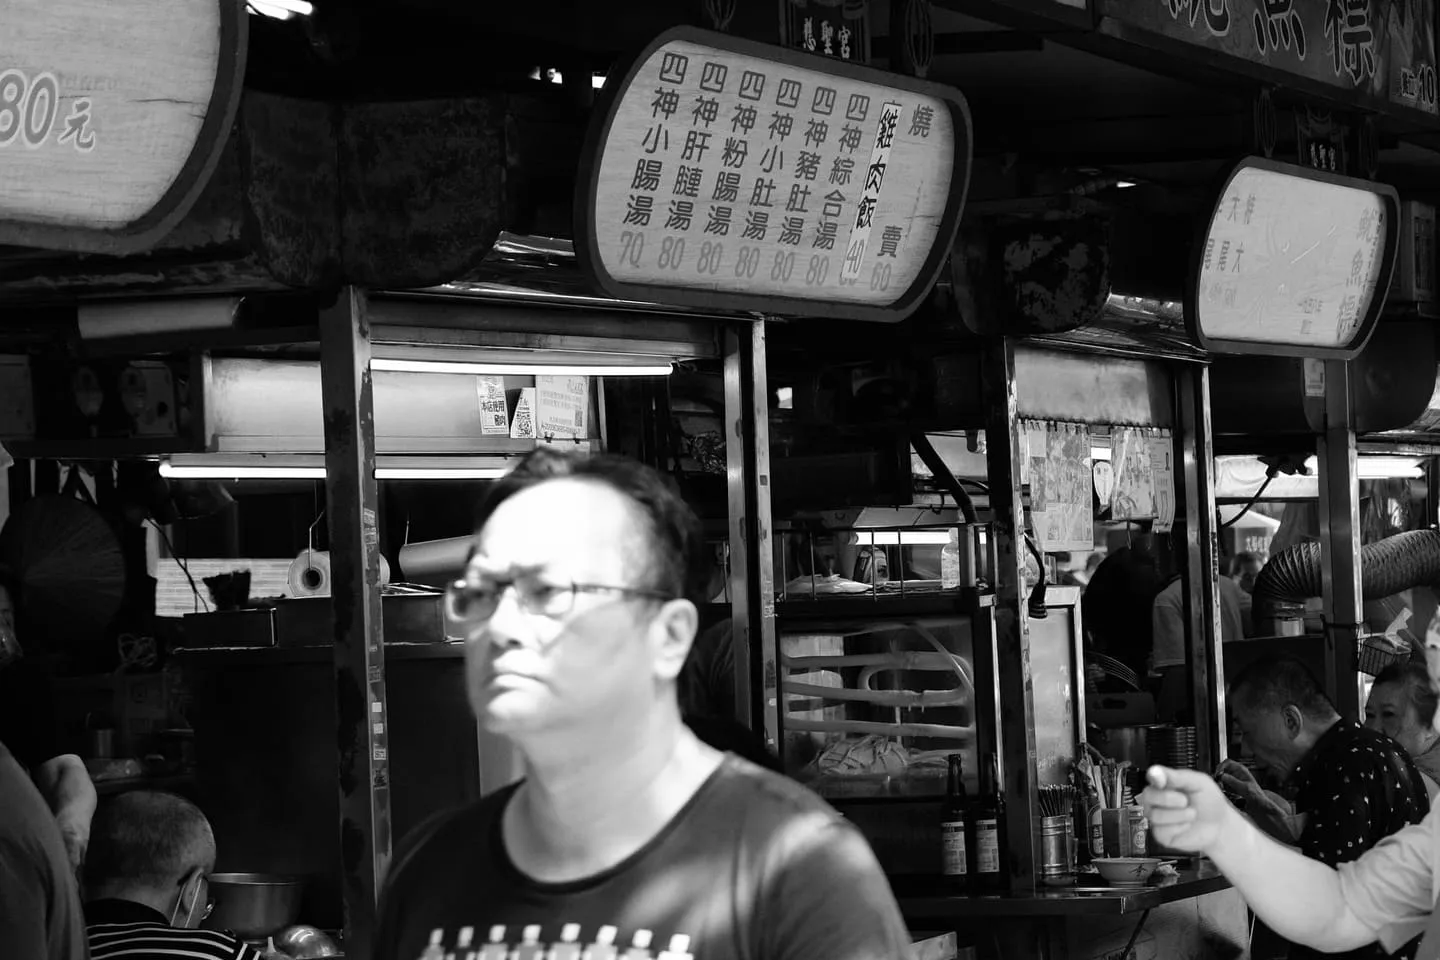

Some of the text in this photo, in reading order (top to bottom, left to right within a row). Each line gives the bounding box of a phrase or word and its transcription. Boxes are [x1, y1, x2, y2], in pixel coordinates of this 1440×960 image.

[617, 52, 689, 268] 四神小腸湯 70
[657, 236, 686, 270] 80
[696, 70, 766, 275] 四神粉腸湯 80
[734, 78, 802, 279] 四神小肚湯 80
[770, 86, 837, 282] 四神豬肚湯 80
[806, 93, 871, 286] 四神綜合湯 80
[846, 106, 899, 275] 雞肉飯 40
[870, 262, 893, 292] 60
